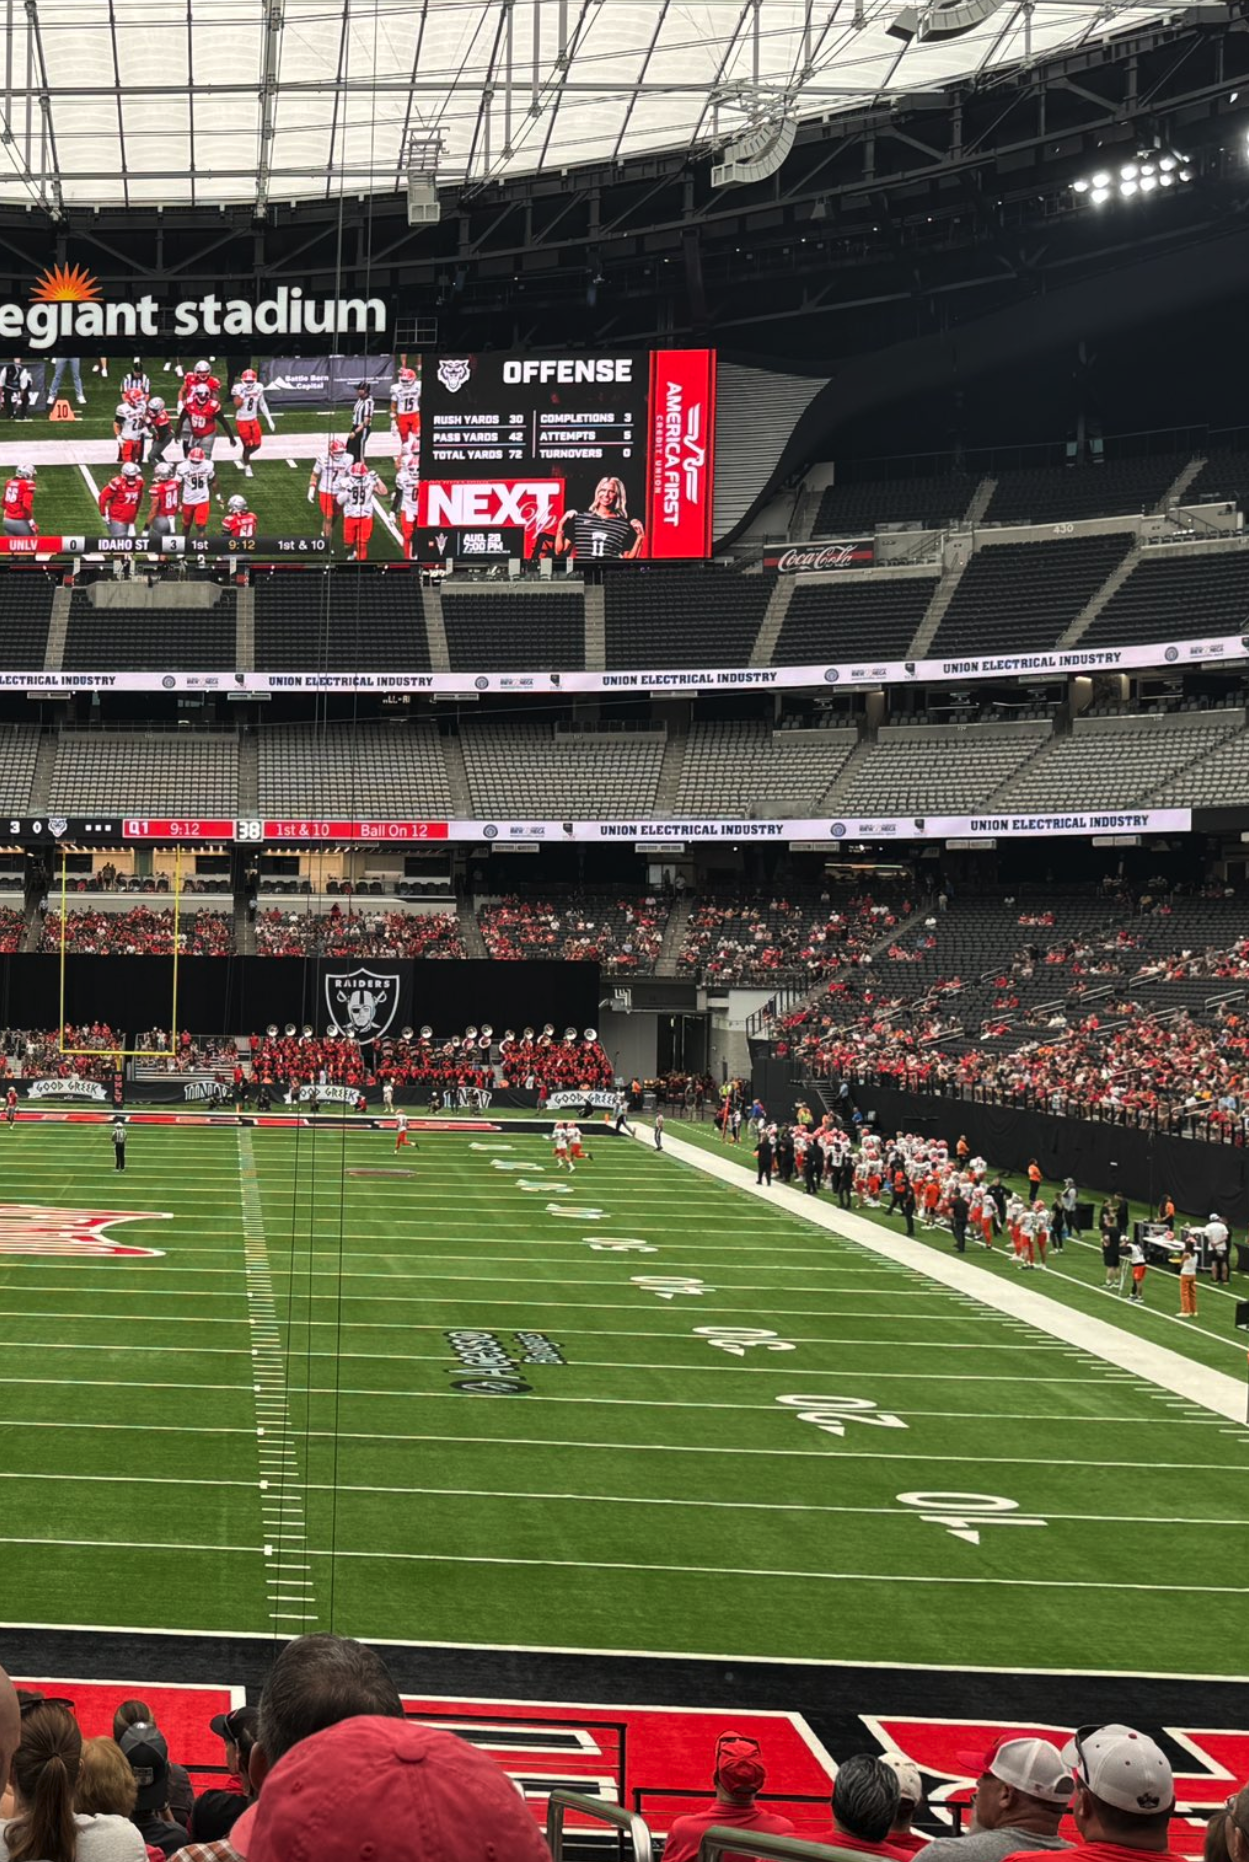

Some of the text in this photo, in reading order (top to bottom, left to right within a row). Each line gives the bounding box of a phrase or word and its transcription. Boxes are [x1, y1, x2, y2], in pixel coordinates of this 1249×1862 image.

[174, 286, 386, 336] stadium
[503, 359, 632, 384] OFFENSE
[57, 404, 69, 418] 10
[433, 414, 524, 425] RUSH YARDS 30
[540, 413, 632, 424] COMPLETIONS 3
[433, 432, 523, 442] PASS YARDS 42
[540, 431, 596, 441] ATTEMPTS
[433, 449, 523, 460] TOTAL YARDS 72
[540, 448, 631, 459] TURNOVERS 0
[663, 381, 682, 527] AMERICA FIRST
[654, 458, 662, 494] UNION
[428, 483, 560, 526] NEXT
[9, 539, 38, 551] UNLV
[69, 539, 77, 550] 0
[98, 539, 149, 550] IDAHO ST
[170, 539, 177, 550] 3
[191, 540, 209, 550] 1st
[228, 540, 256, 550] 9:12
[278, 540, 325, 550] 1st & 10
[487, 541, 504, 550] PM
[777, 544, 858, 572] Coca-Cola
[943, 652, 1121, 674] UNION ELECTRICAL INDUSTRY
[61, 675, 116, 686] INDUSTRY
[268, 676, 433, 686] UNION ELECTRICAL INDUSTRY
[602, 671, 777, 686] UNION ELECTRICAL INDUSTRY
[10, 821, 21, 833] 3
[32, 821, 42, 833] 0
[129, 822, 149, 835] Q1
[170, 823, 199, 836] 9:12
[276, 823, 329, 836] 1st & 10
[600, 822, 784, 836] UNION ELECTRICAL INDUSTRY
[971, 814, 1149, 832] UNION ELECTRICAL INDUSTRY
[238, 821, 260, 840] 38
[361, 824, 428, 837] Ball On 12
[335, 979, 390, 988] RAIDERS
[36, 1081, 98, 1093] GOOD GREEK
[296, 1087, 357, 1101] OOD GREEK
[554, 1091, 583, 1105] GOOD
[692, 1326, 797, 1351] 30
[775, 1394, 910, 1429] 20
[896, 1490, 1049, 1527] 10
